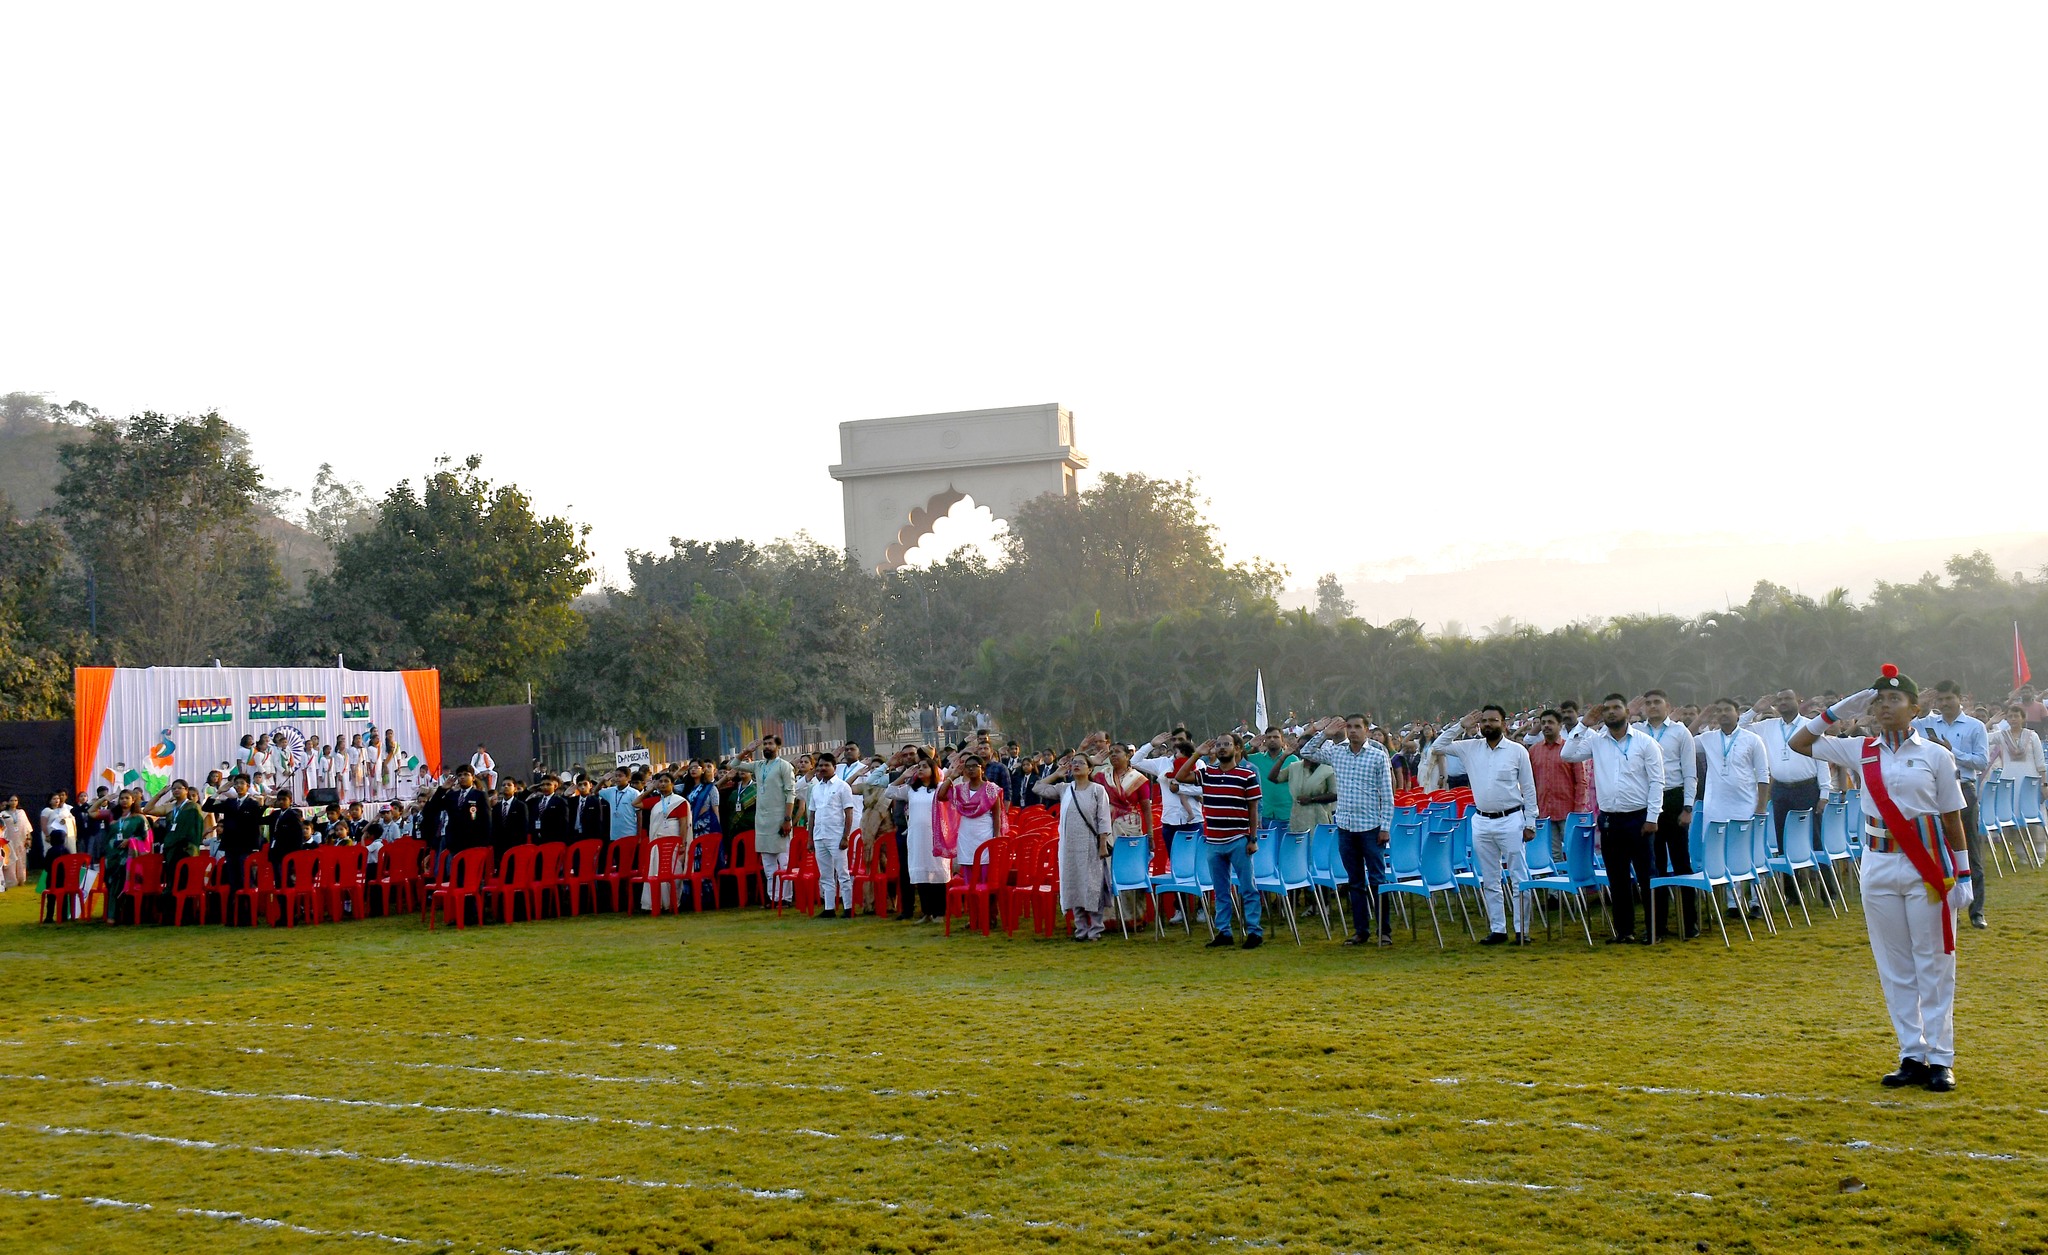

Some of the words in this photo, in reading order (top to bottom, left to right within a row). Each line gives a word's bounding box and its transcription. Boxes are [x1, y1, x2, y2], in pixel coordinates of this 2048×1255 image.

[178, 698, 230, 723] HAPPY
[249, 695, 322, 719] REPUBLIC
[343, 696, 368, 718] DAY
